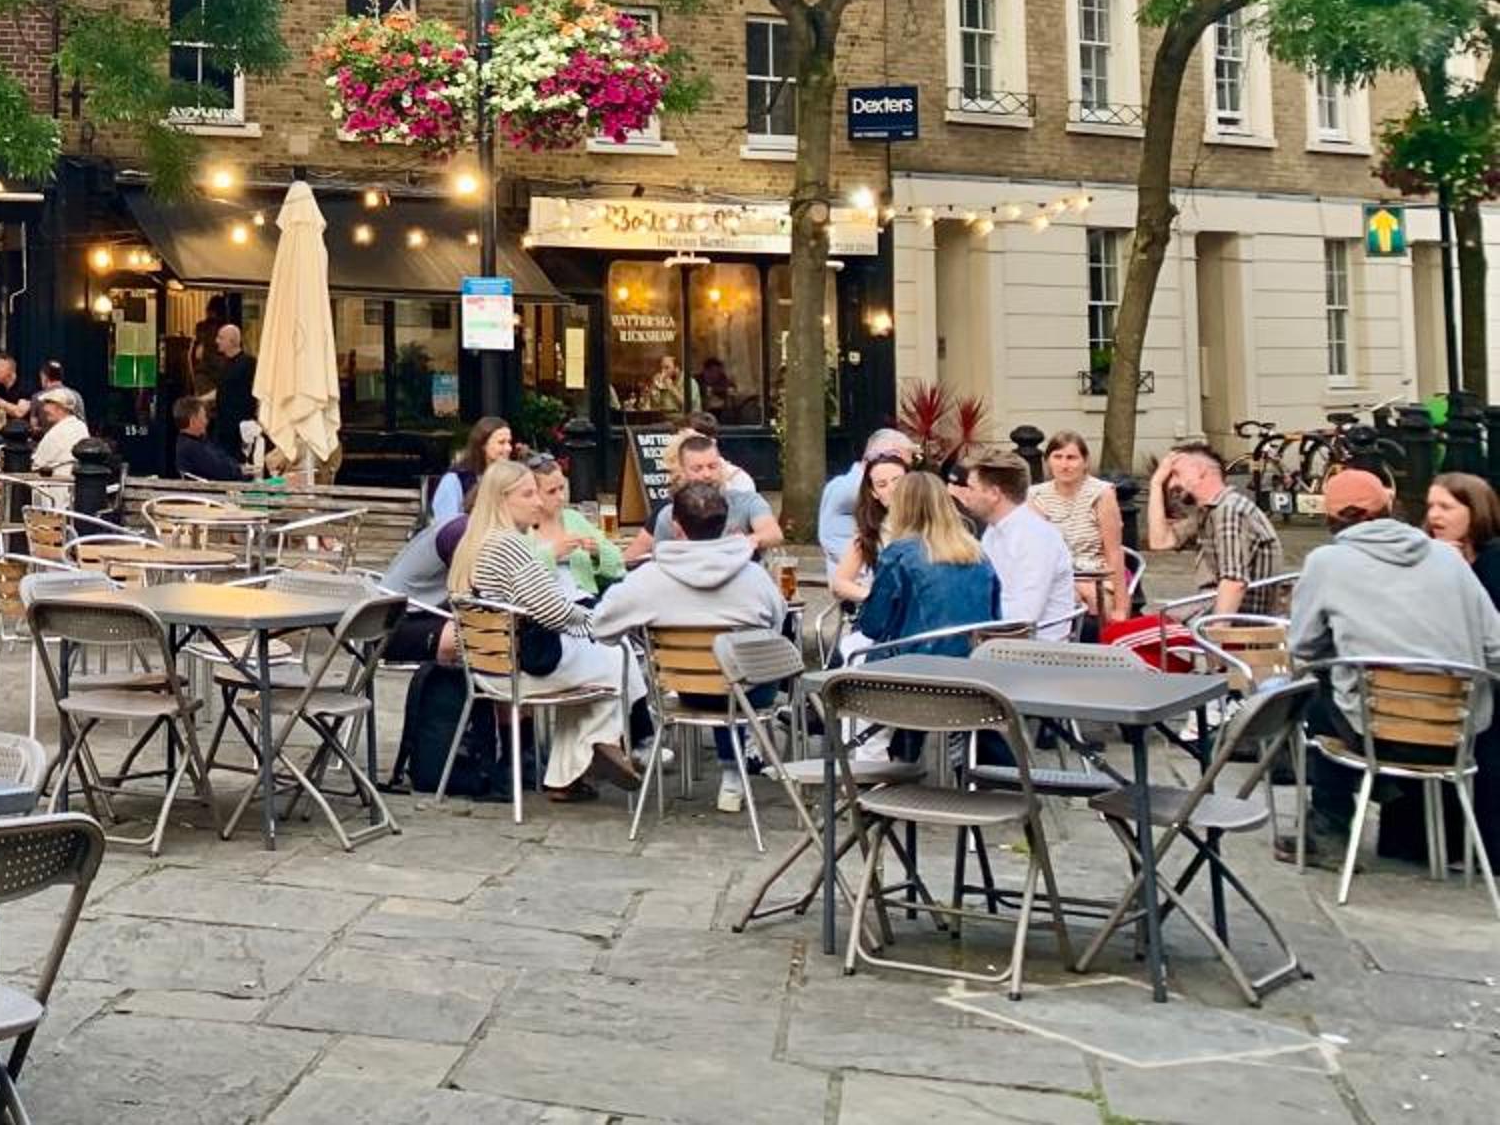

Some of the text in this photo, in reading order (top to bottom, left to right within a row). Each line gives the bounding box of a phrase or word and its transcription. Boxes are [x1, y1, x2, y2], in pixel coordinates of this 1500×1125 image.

[853, 97, 913, 113] Dexters
[612, 315, 675, 327] BATTERSEA
[619, 330, 676, 342] RICKSHAW
